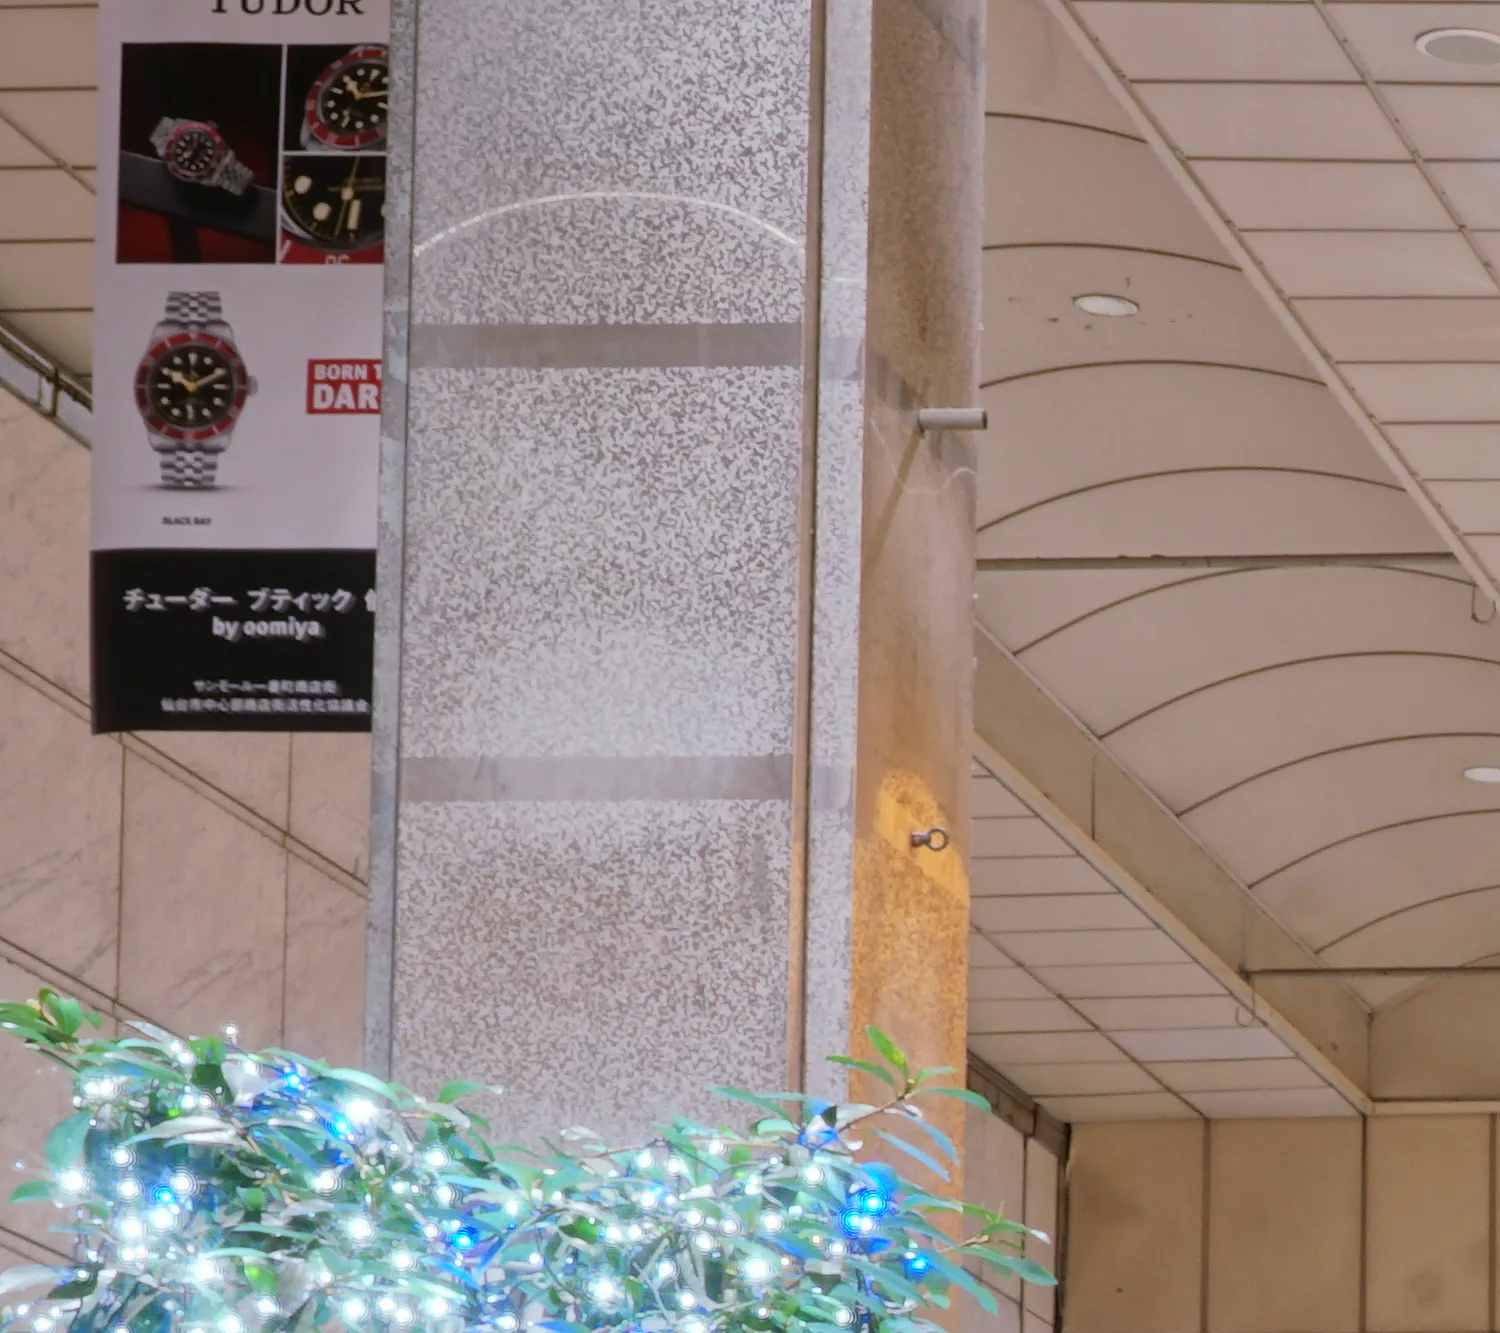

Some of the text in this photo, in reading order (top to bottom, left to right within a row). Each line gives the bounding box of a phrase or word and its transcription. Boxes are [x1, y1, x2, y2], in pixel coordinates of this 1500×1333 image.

[313, 364, 366, 380] BORN
[313, 384, 378, 409] DAR
[123, 587, 238, 612] チューダー
[247, 587, 355, 613] ブティック
[212, 616, 323, 642] by oomiya
